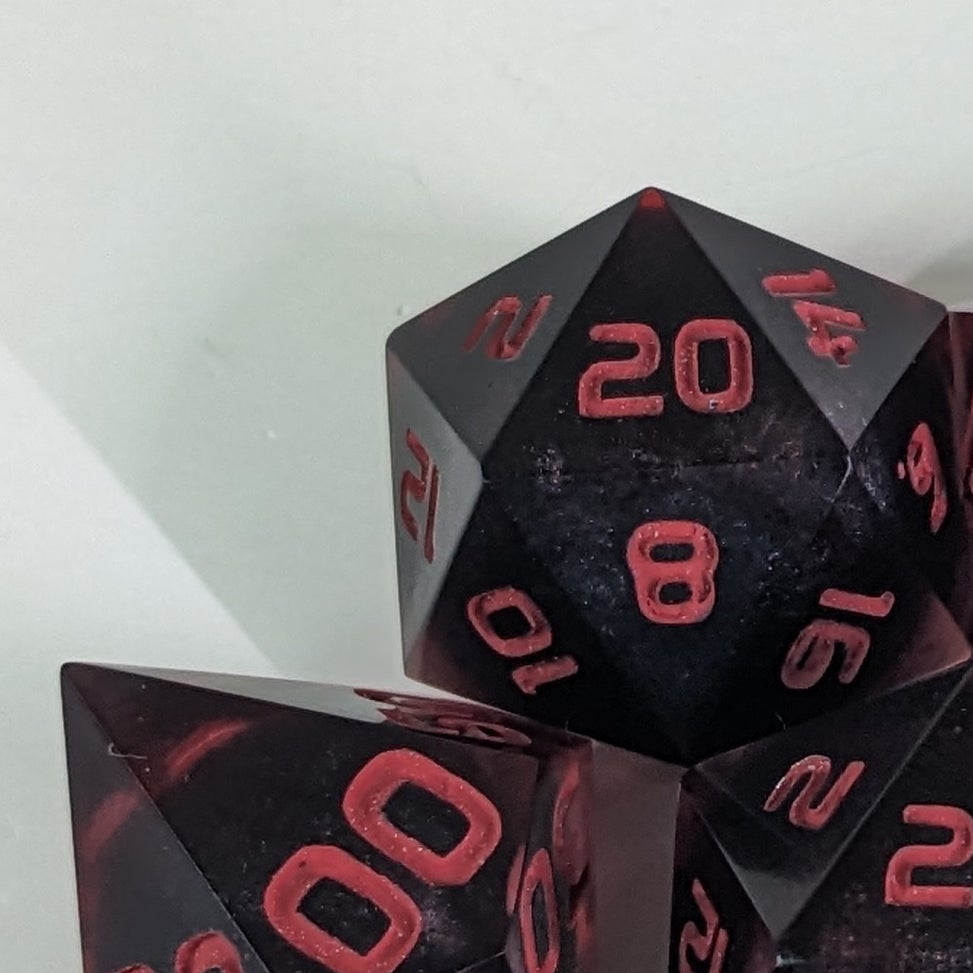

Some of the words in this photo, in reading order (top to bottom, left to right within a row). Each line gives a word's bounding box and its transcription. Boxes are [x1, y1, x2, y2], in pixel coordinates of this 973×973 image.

[465, 295, 552, 360] 2
[762, 269, 866, 367] 14
[579, 318, 753, 419] 20
[627, 520, 719, 625] 8
[467, 585, 579, 695] 10
[781, 589, 895, 689] 16
[763, 754, 866, 830] 2
